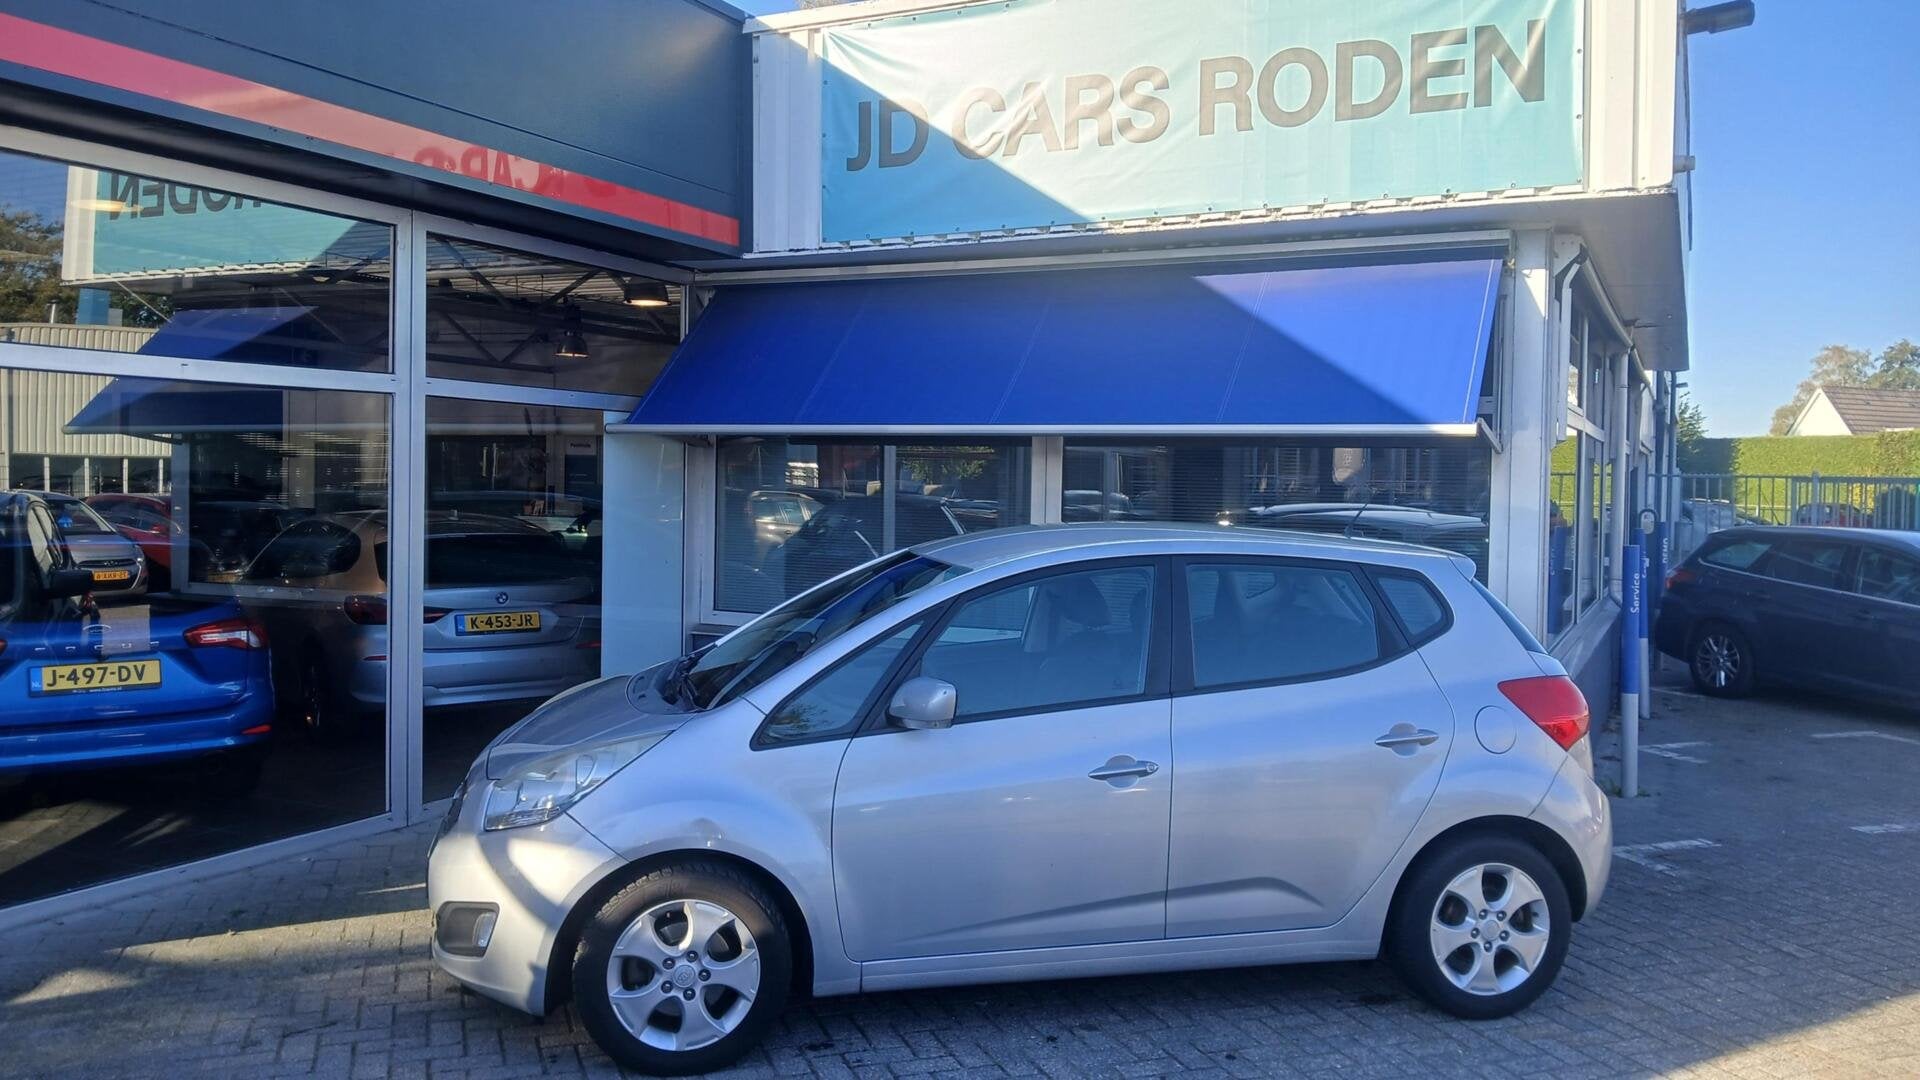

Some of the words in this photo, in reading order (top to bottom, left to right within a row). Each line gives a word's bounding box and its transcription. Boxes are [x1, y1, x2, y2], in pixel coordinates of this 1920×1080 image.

[846, 101, 928, 172] JD
[951, 66, 1170, 160] CARS
[1198, 19, 1546, 137] RODEN
[470, 614, 533, 629] K-453-JR
[46, 664, 146, 687] J-497-DV
